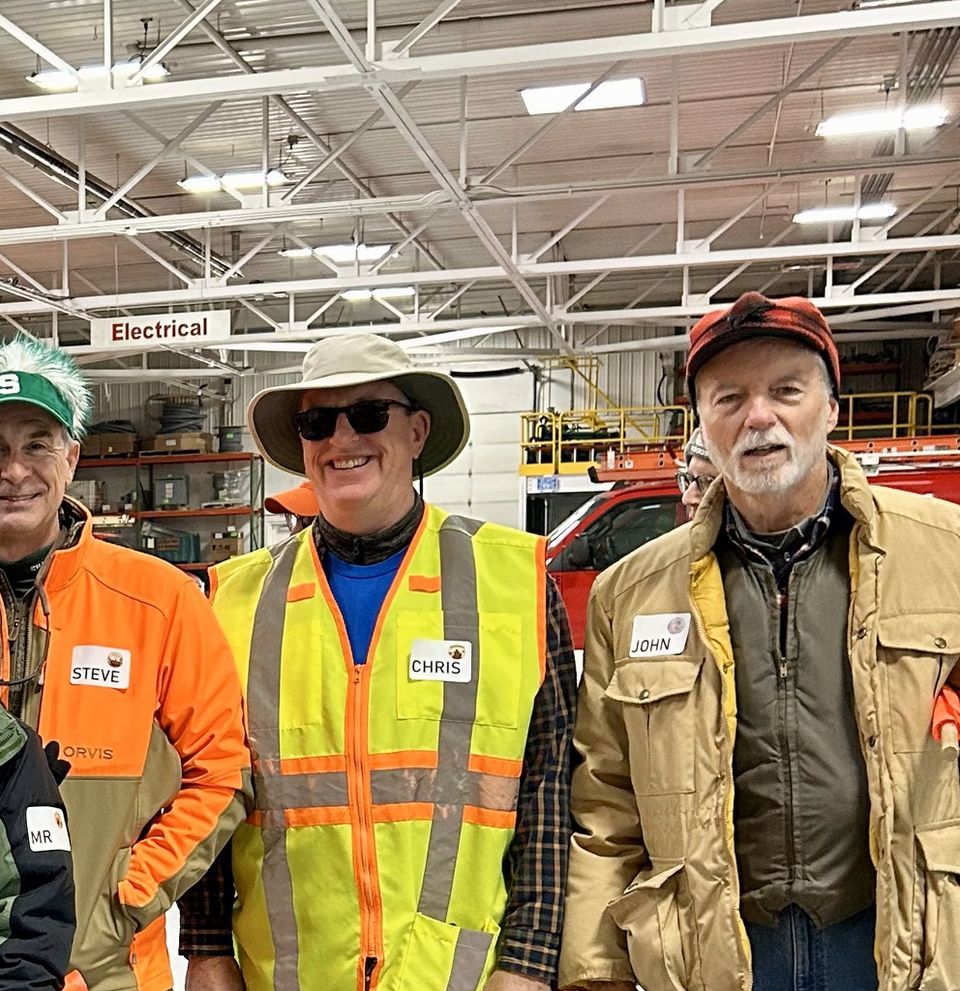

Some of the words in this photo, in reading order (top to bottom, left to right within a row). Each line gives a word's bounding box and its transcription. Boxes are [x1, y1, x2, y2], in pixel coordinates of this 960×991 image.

[111, 317, 208, 342] Electrical
[631, 637, 671, 653] JOHN
[411, 659, 461, 675] CHRIS
[72, 667, 120, 684] STEVE
[63, 746, 114, 760] ORVIS
[31, 830, 53, 845] MR
